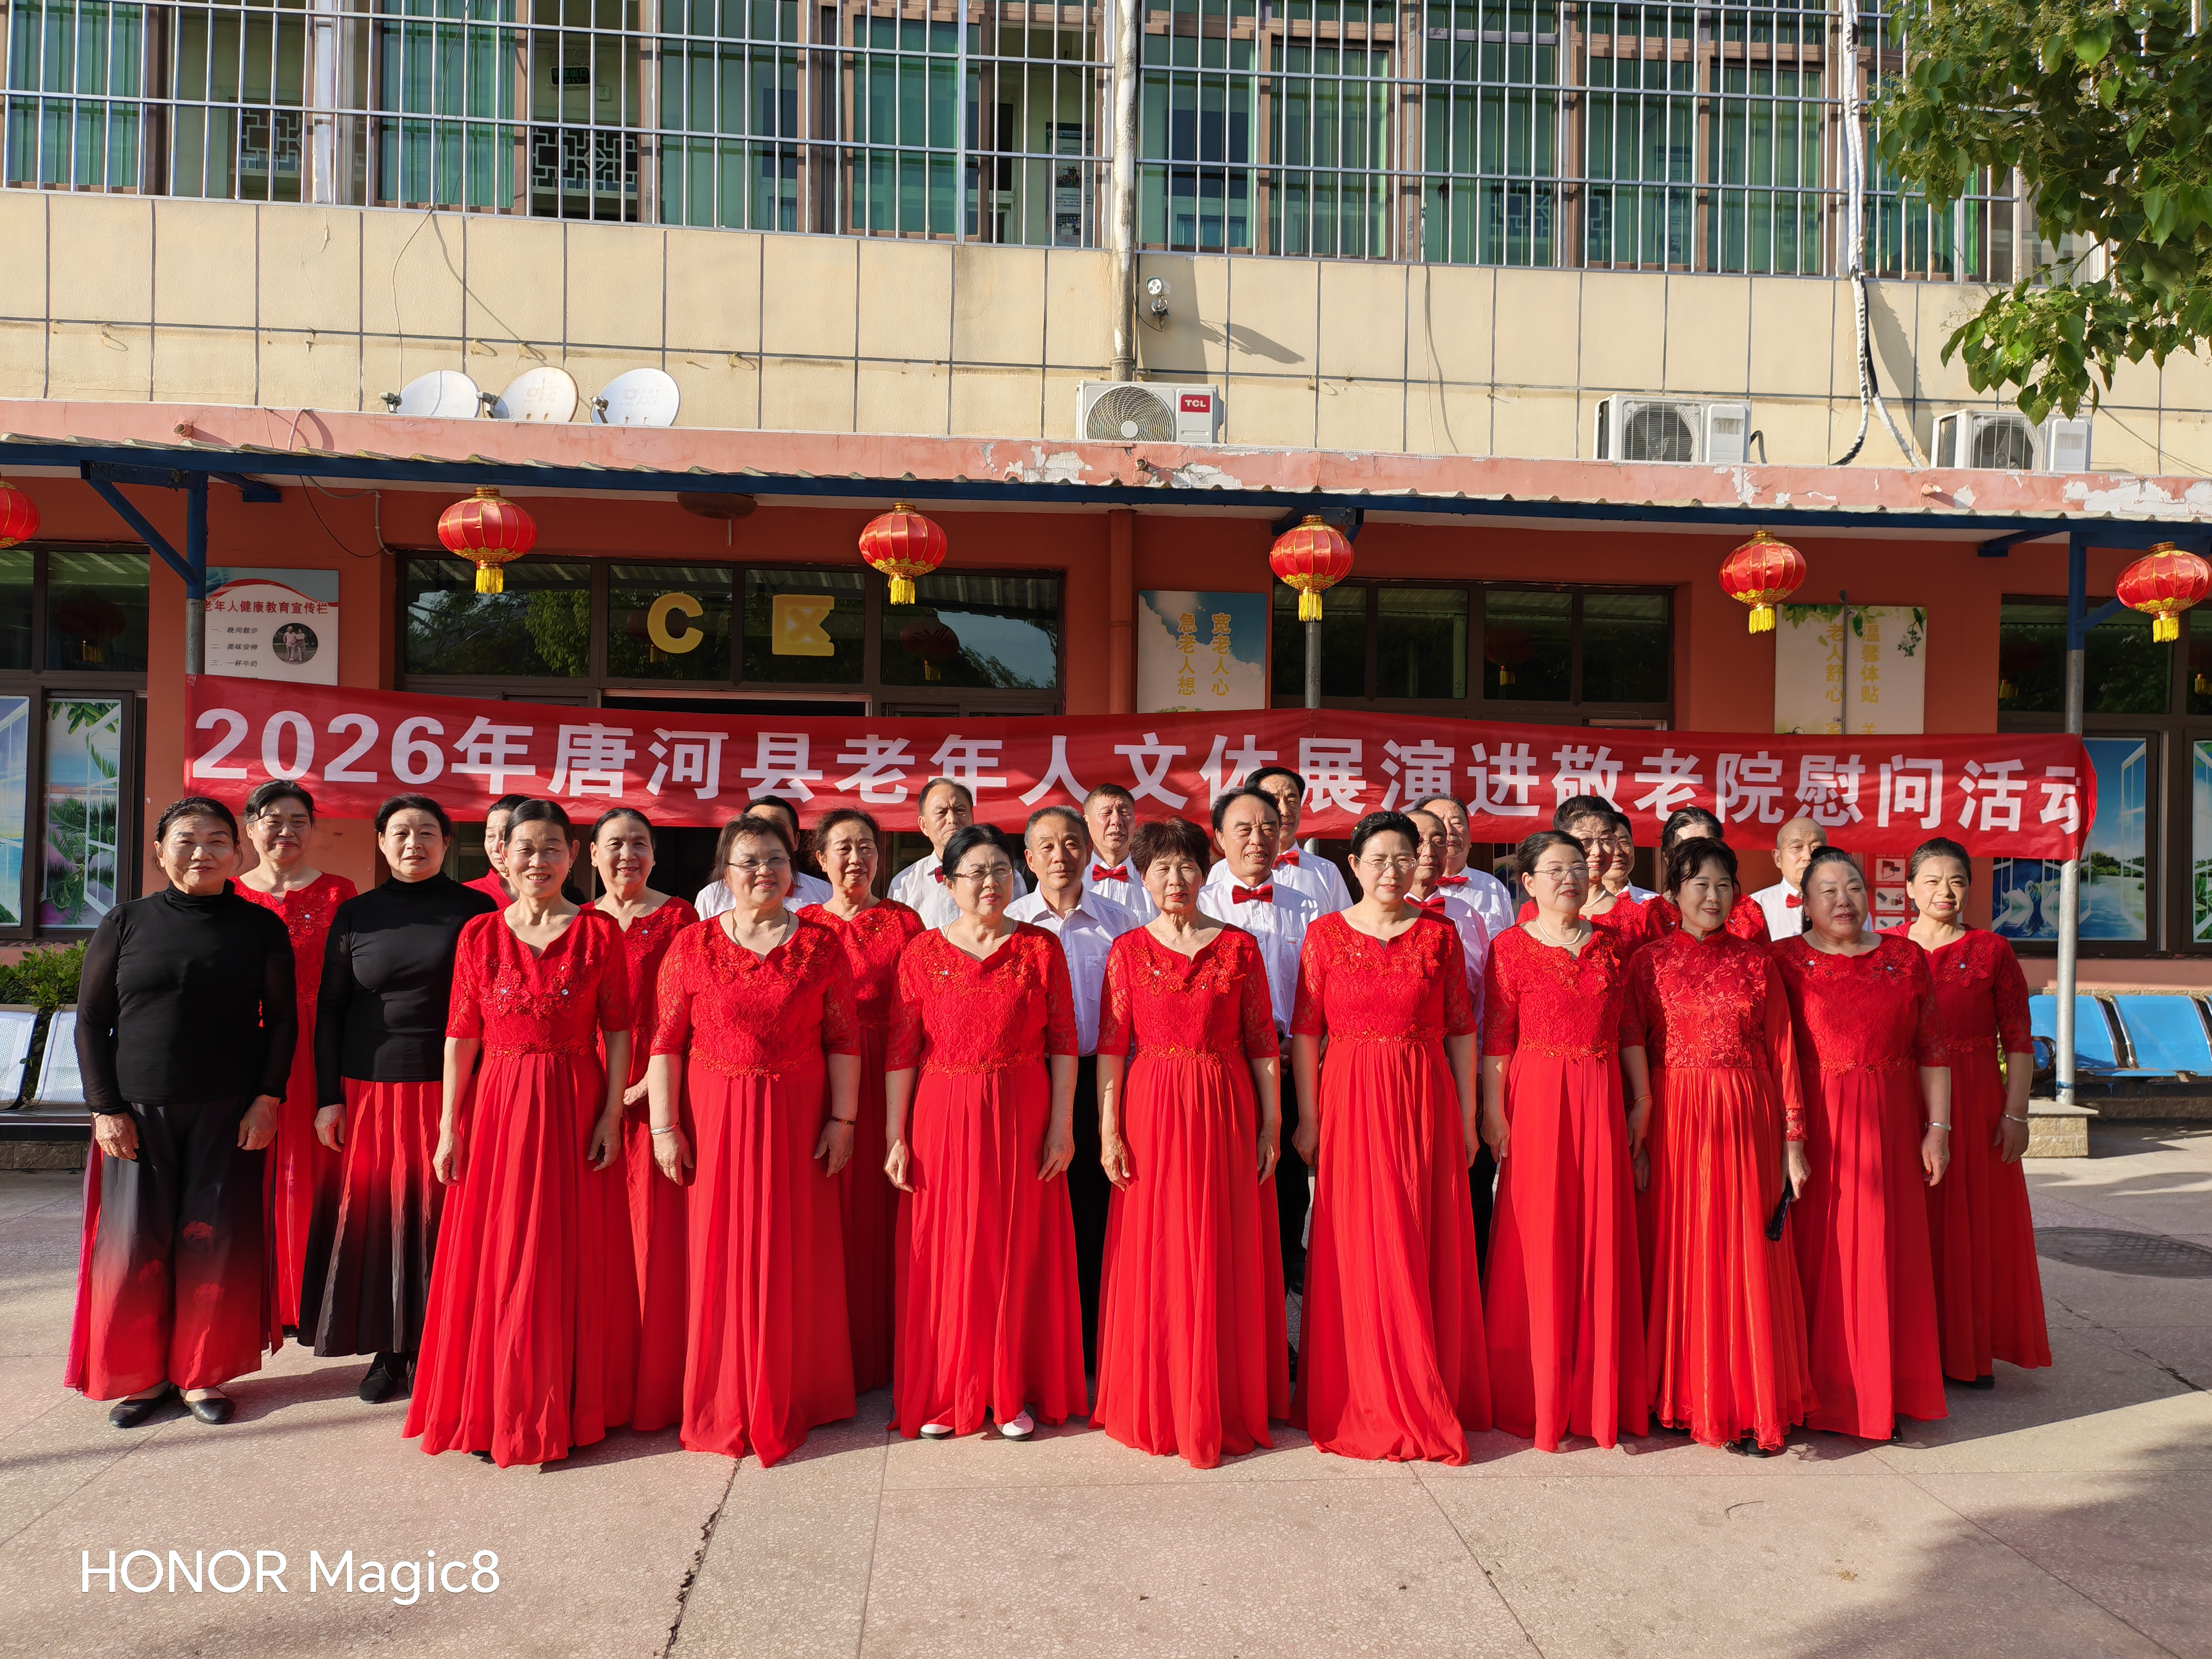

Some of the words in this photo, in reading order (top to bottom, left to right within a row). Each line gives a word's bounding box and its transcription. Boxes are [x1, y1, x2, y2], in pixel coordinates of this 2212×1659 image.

[1184, 399, 1206, 408] TCL
[205, 599, 329, 614] 老年人健康教育宣传栏
[647, 592, 704, 654] C
[772, 594, 835, 657] 区
[1177, 612, 1198, 696] 急老人想
[1211, 612, 1232, 696] 宽老人心
[1825, 623, 1844, 703] 老人舒心
[1860, 624, 1880, 703] 温馨体贴
